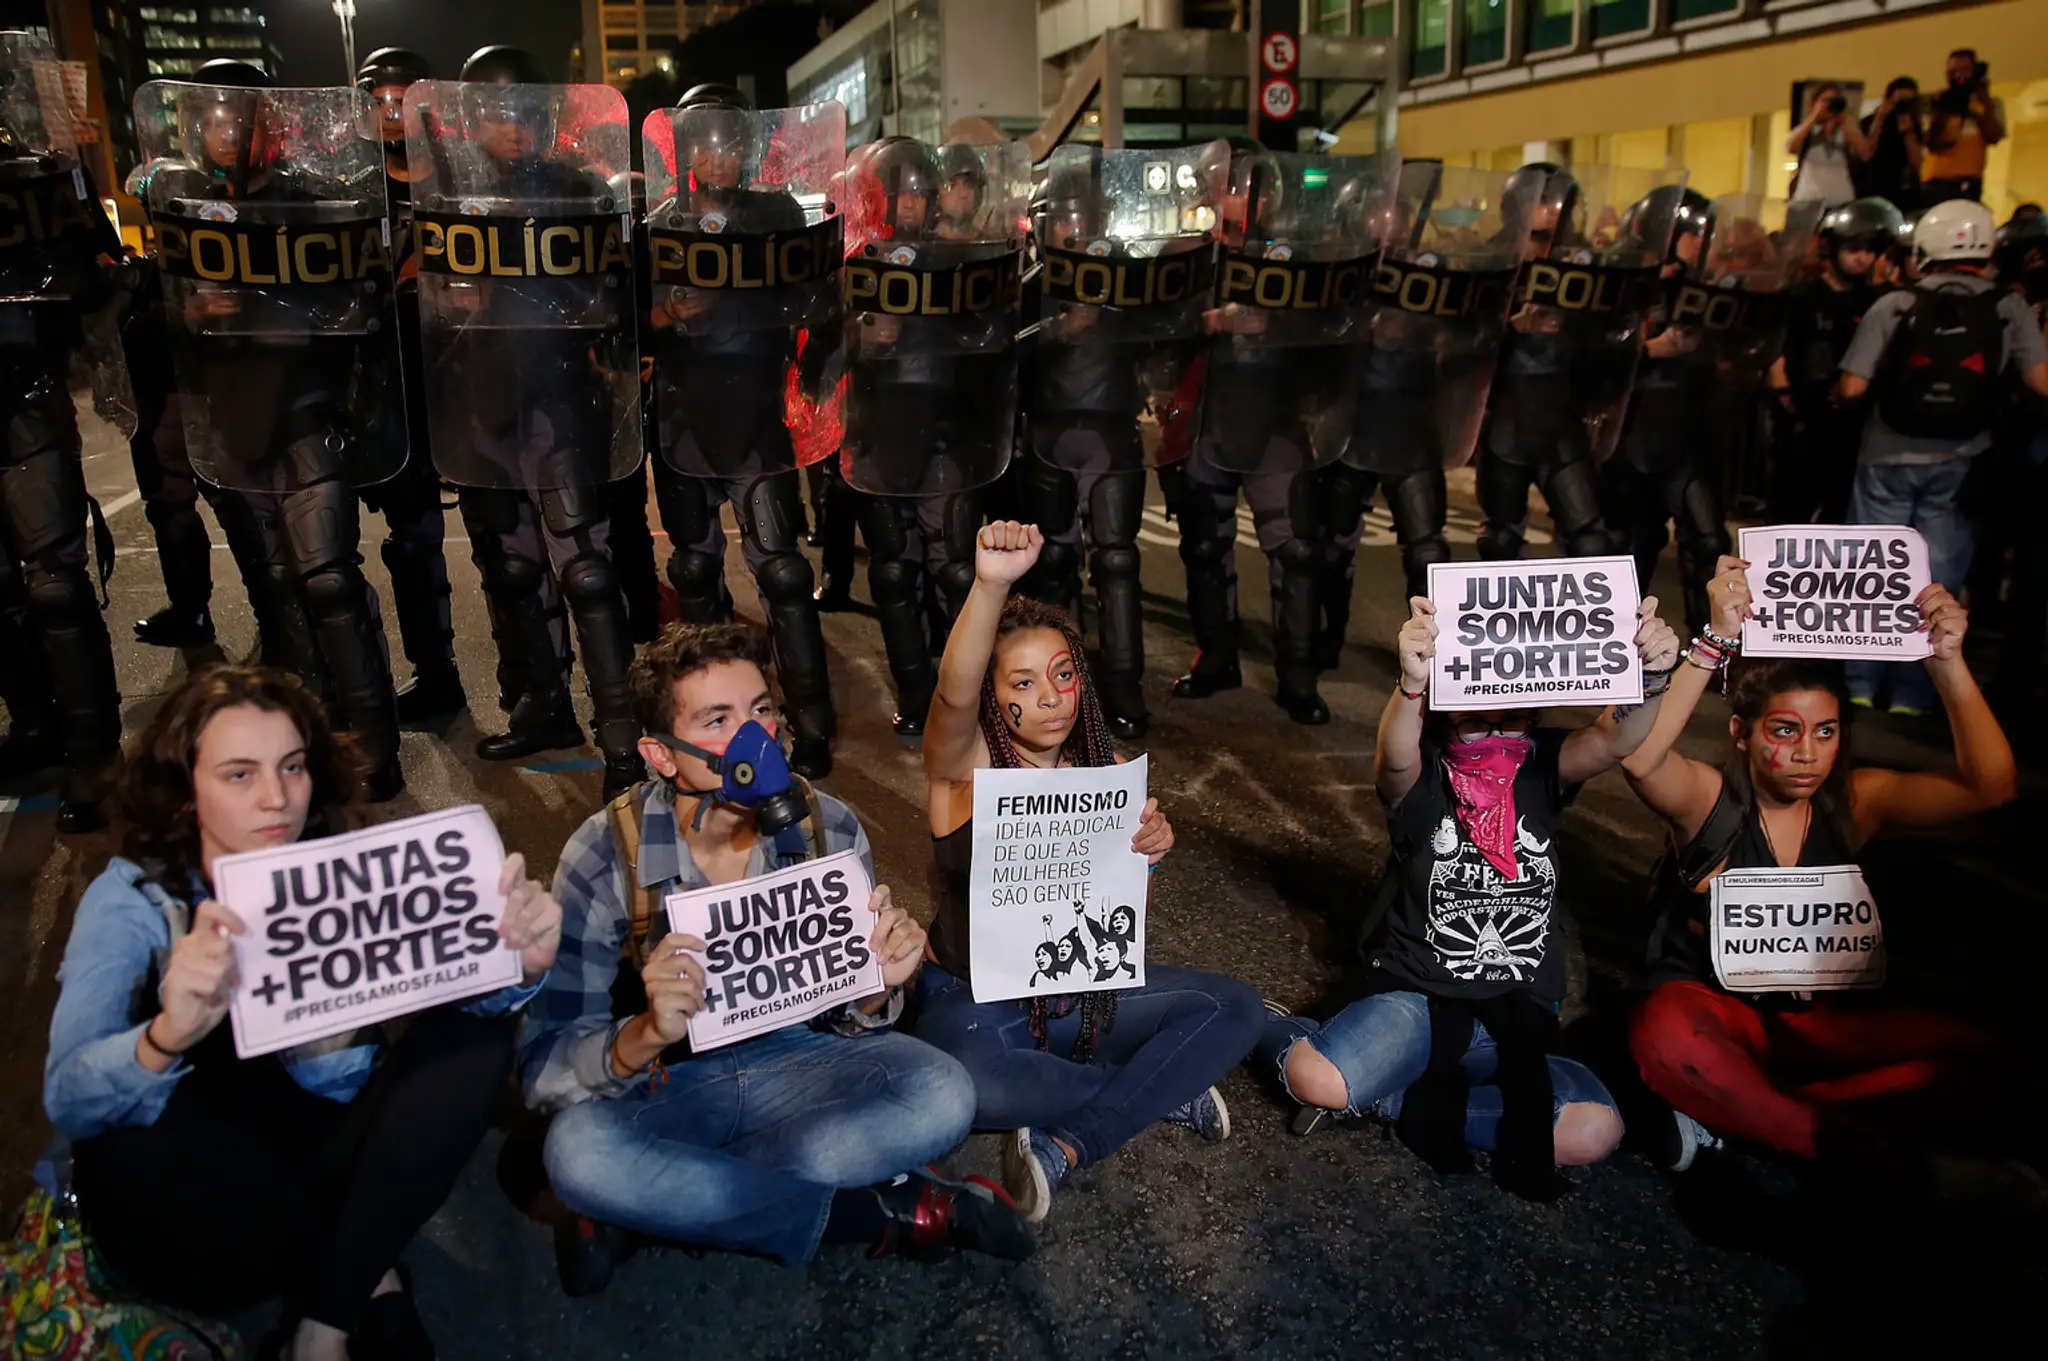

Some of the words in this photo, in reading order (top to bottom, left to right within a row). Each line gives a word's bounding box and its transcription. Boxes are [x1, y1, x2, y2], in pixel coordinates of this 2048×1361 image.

[1268, 86, 1291, 107] 50
[155, 221, 388, 284] POLÍCIA
[415, 217, 632, 276] POLÍCIA
[1768, 538, 1910, 569] JUNTAS
[1459, 572, 1612, 611] JUNTAS
[1762, 571, 1911, 600] SOMOS
[1457, 607, 1615, 646] SOMOS
[1753, 602, 1919, 634] +FORTES
[1772, 633, 1903, 647] #PRECISAMOSFALAR
[1444, 641, 1629, 681] +FORTES
[1463, 678, 1611, 695] #PRECISAMOSFALAR
[997, 789, 1128, 817] FEMINISMO
[995, 818, 1043, 840] IDÉIA
[1049, 815, 1125, 837] RADICAL
[994, 845, 1018, 862] DE
[1023, 843, 1061, 861] QUE
[1066, 839, 1090, 857] AS
[264, 830, 471, 916] JUNTAS
[992, 860, 1091, 884] MULHERES
[704, 869, 849, 940] JUNTAS
[991, 885, 1028, 908] SÃO
[1033, 881, 1091, 904] GENTE
[1435, 889, 1456, 900] YES
[265, 875, 479, 957] SOMOS
[1724, 900, 1873, 928] ESTUPRO
[705, 905, 854, 975] SOMOS
[1724, 937, 1809, 955] NUNCA
[1815, 934, 1877, 953] MAIS!
[251, 913, 501, 1007] +FORTES
[703, 935, 870, 1014] +FORTES
[283, 961, 481, 1024] #PRECISAMOSFALAR
[722, 975, 857, 1027] #PRECISAMOSFALAR
